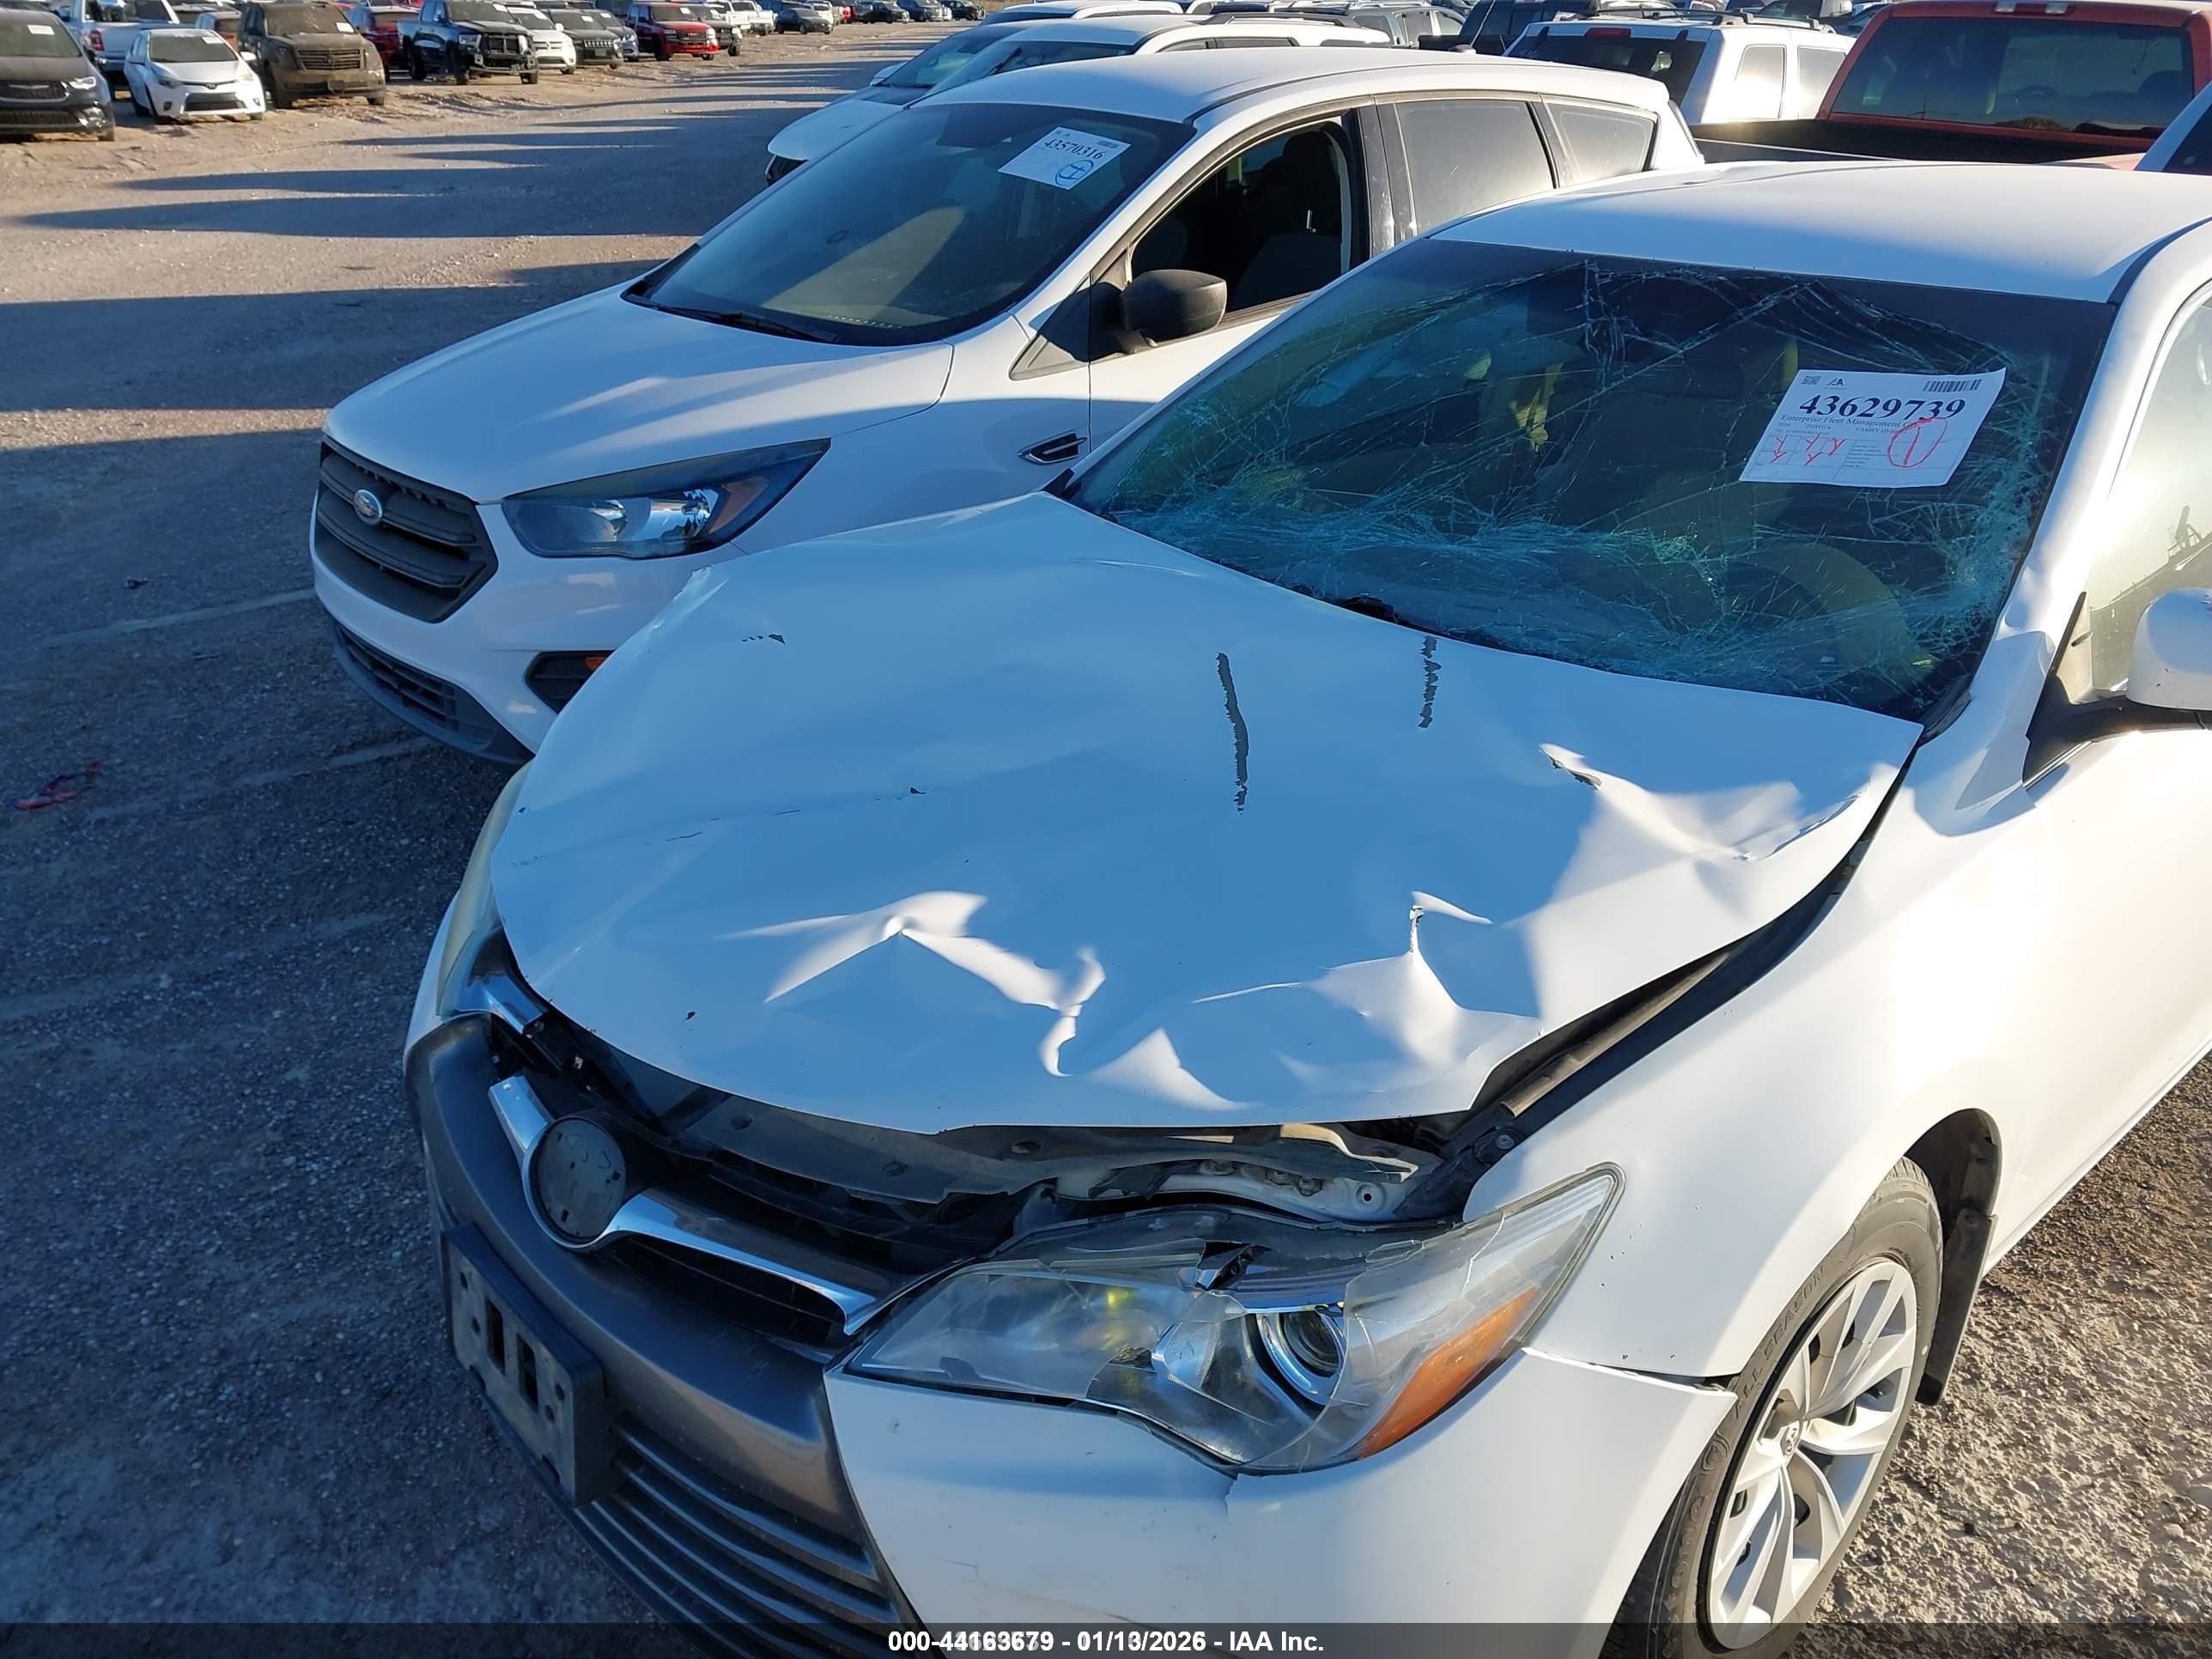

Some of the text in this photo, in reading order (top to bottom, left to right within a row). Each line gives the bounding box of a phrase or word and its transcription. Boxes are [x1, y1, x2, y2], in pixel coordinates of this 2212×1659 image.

[1043, 138, 1107, 159] 43570316
[1799, 394, 1966, 421] 43629739
[1781, 414, 1821, 423] Enterprise
[1823, 416, 1844, 425] Fleet
[1846, 418, 1901, 428] Management
